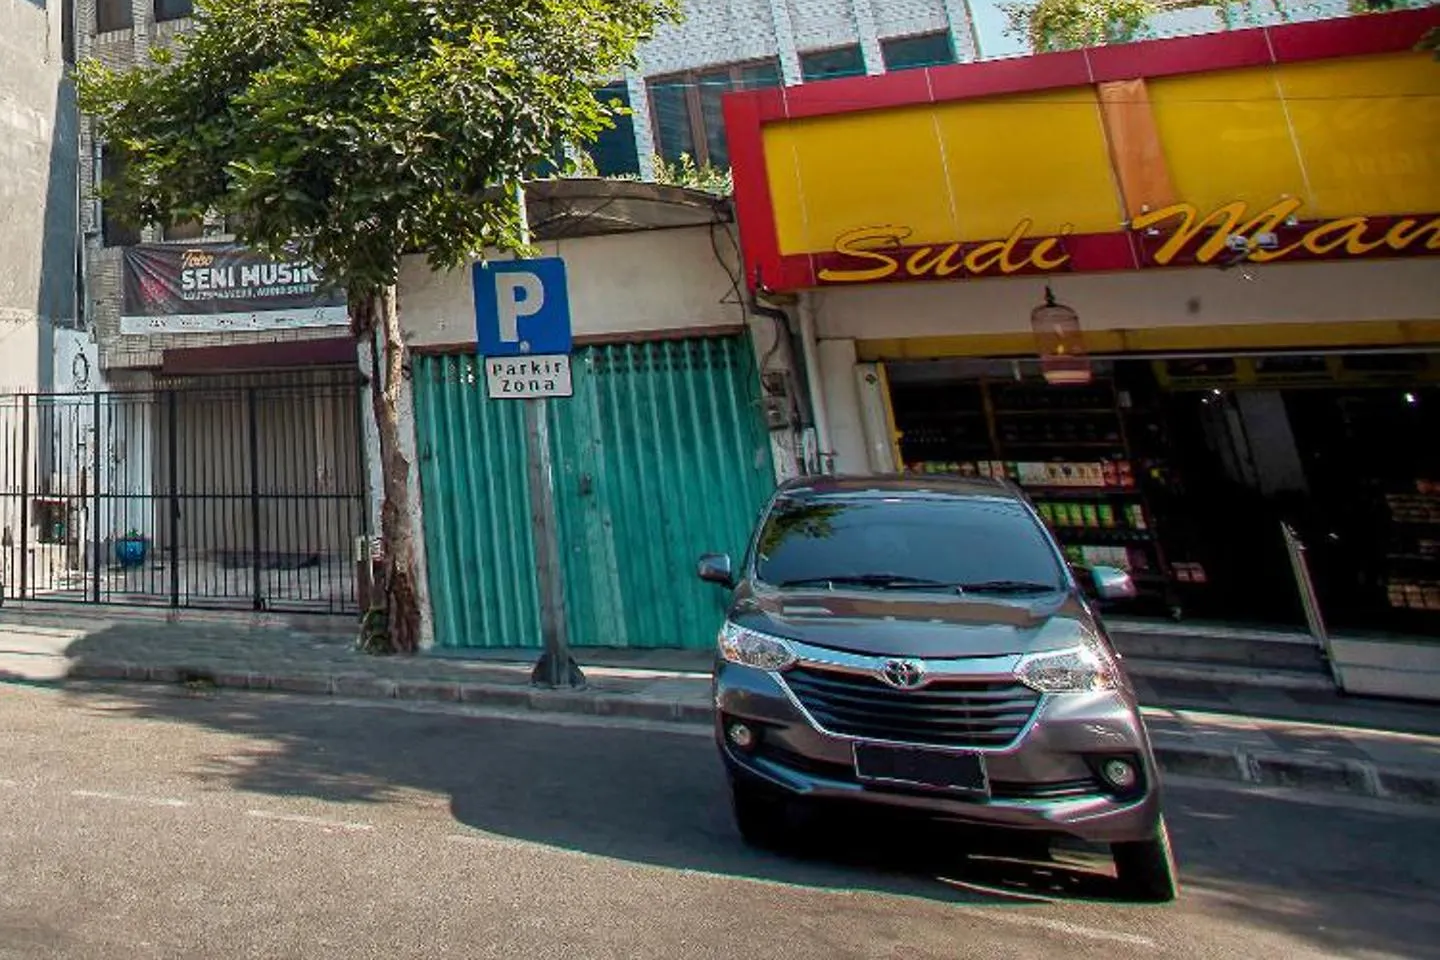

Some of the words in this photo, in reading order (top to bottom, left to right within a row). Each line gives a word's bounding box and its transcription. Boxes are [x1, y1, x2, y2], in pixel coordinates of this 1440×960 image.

[817, 218, 1076, 282] Sudi
[182, 266, 231, 290] SENI
[495, 271, 544, 343] P
[492, 360, 562, 376] Parkir
[502, 379, 555, 393] Zona
